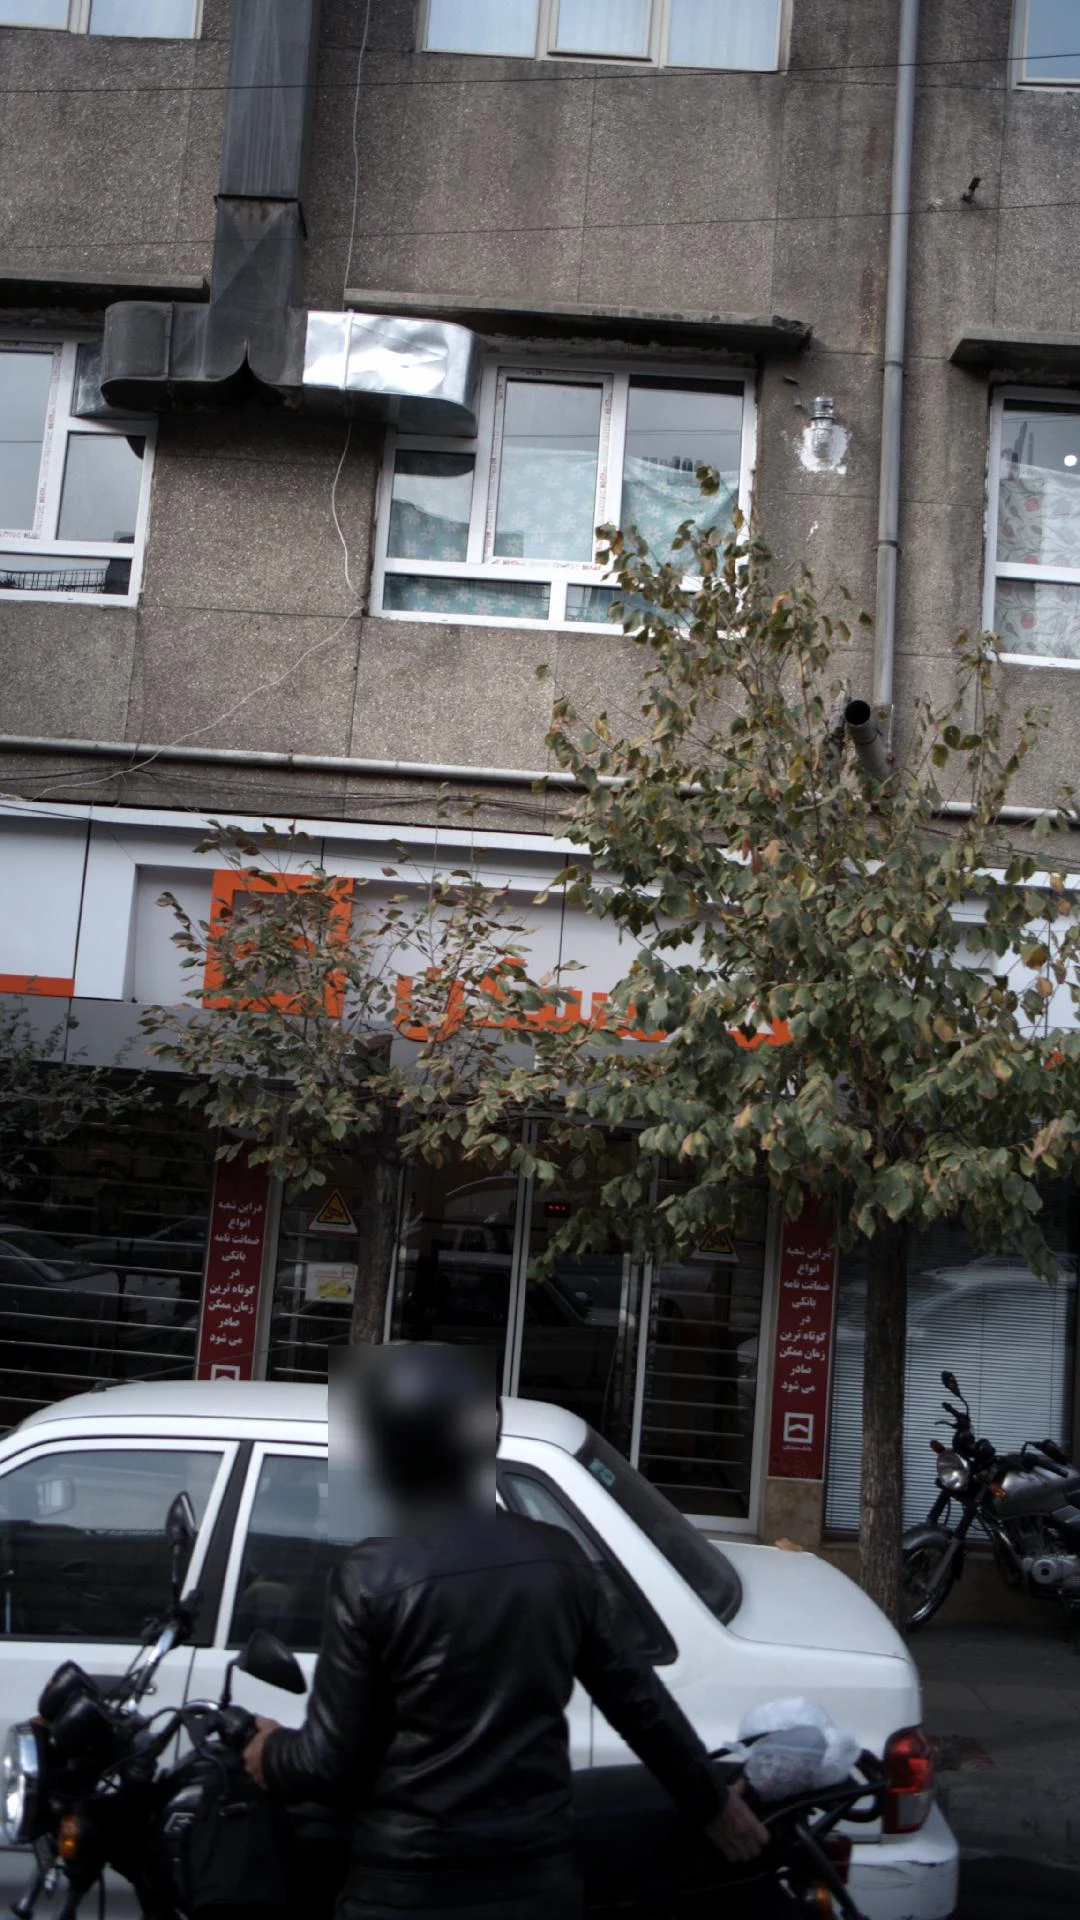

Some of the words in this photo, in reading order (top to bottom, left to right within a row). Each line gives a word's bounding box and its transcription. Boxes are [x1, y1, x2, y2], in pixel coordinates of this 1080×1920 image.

[217, 1200, 237, 1212] شعبه
[228, 1217, 250, 1230] انواع
[213, 1232, 231, 1243] نامه
[232, 1232, 260, 1245] ضمانت
[221, 1250, 247, 1263] بانکی
[785, 1246, 805, 1257] شعبه
[227, 1268, 240, 1280] در
[796, 1263, 820, 1276] انواع
[208, 1282, 231, 1294] ترین
[783, 1278, 800, 1289] نامه
[801, 1279, 830, 1291] ضمانت
[231, 1284, 256, 1297] کوتاه
[207, 1299, 232, 1311] ممکن
[232, 1301, 254, 1314] زمان
[791, 1296, 817, 1310] بانکی
[217, 1316, 240, 1328] صادر
[799, 1315, 811, 1326] در
[209, 1332, 227, 1345] شود
[228, 1337, 244, 1346] می
[779, 1329, 801, 1342] ترین
[803, 1331, 827, 1343] کوتاه
[779, 1346, 803, 1358] ممکن
[804, 1348, 826, 1361] زمان
[789, 1364, 812, 1376] صادر
[781, 1380, 799, 1392] شود
[801, 1385, 816, 1394] می
